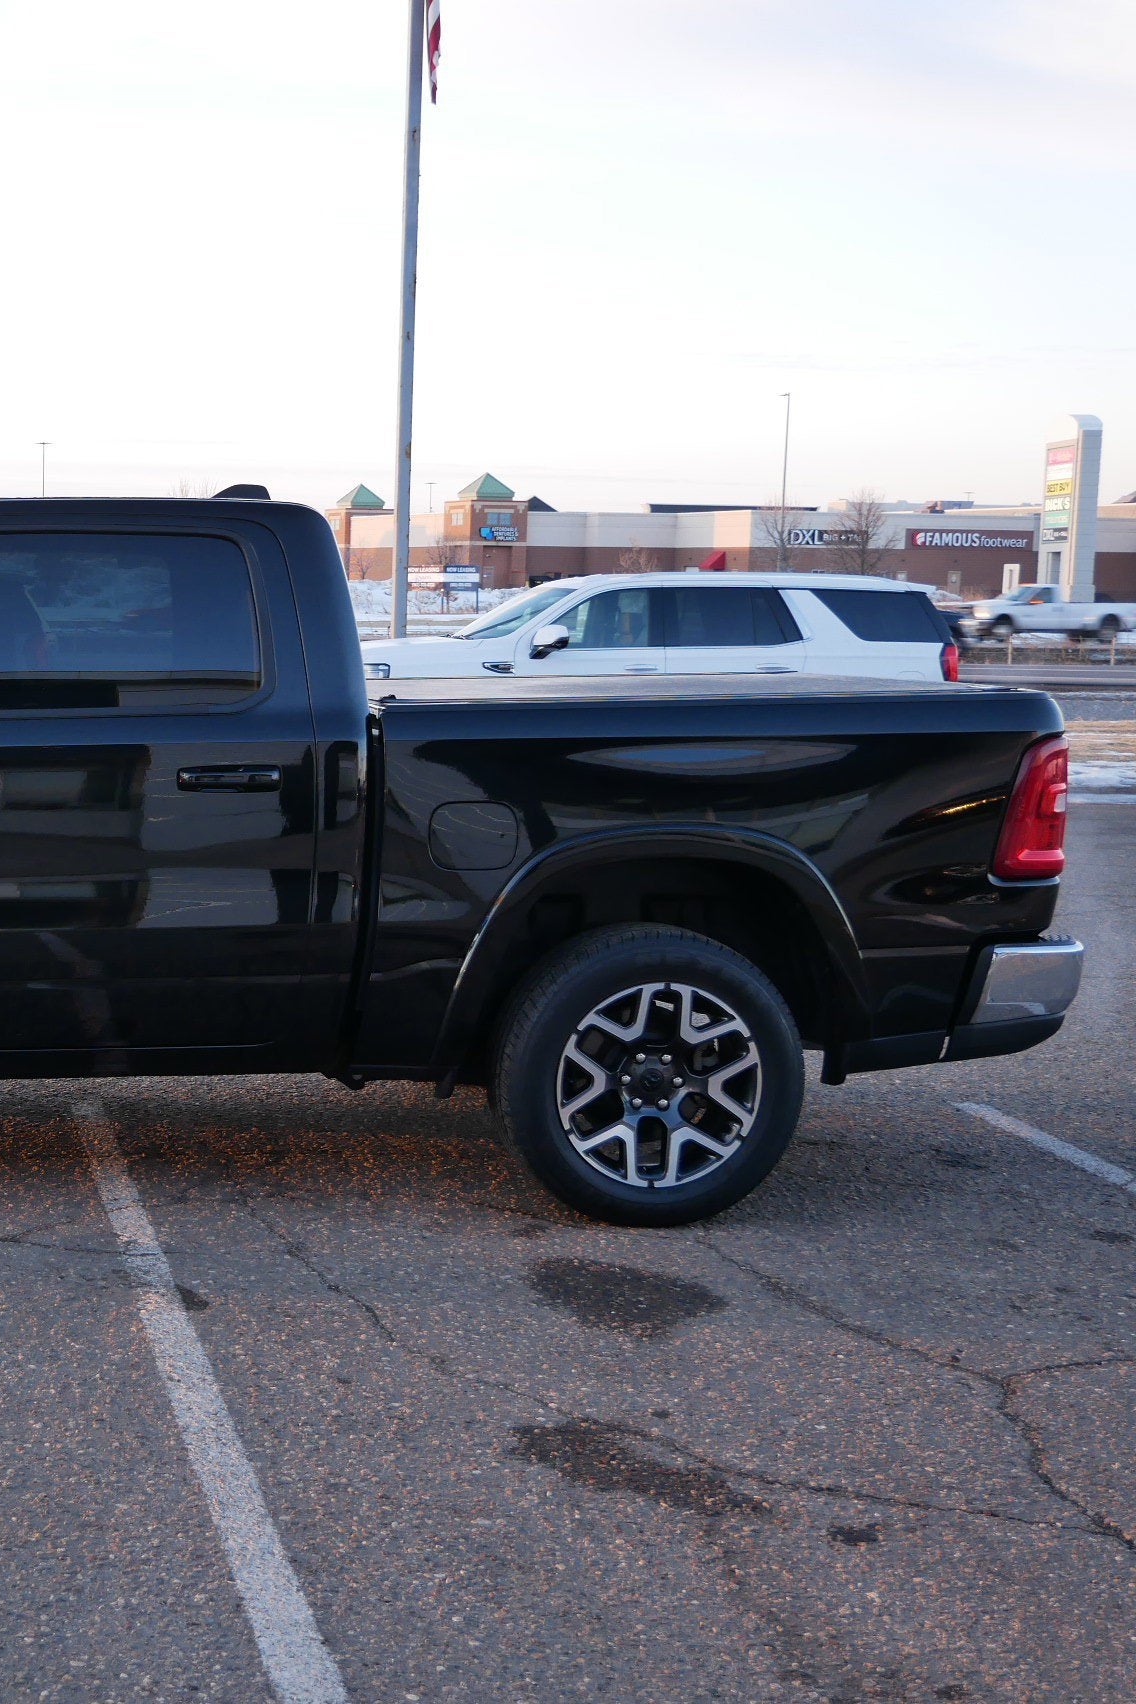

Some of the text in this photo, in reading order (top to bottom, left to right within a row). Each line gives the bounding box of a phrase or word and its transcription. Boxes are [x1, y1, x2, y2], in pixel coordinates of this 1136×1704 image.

[1047, 481, 1070, 493] BEST BUY
[1045, 497, 1070, 511] DICK'S
[790, 530, 824, 545] DXL
[925, 532, 1028, 548] FAMOUS footwear
